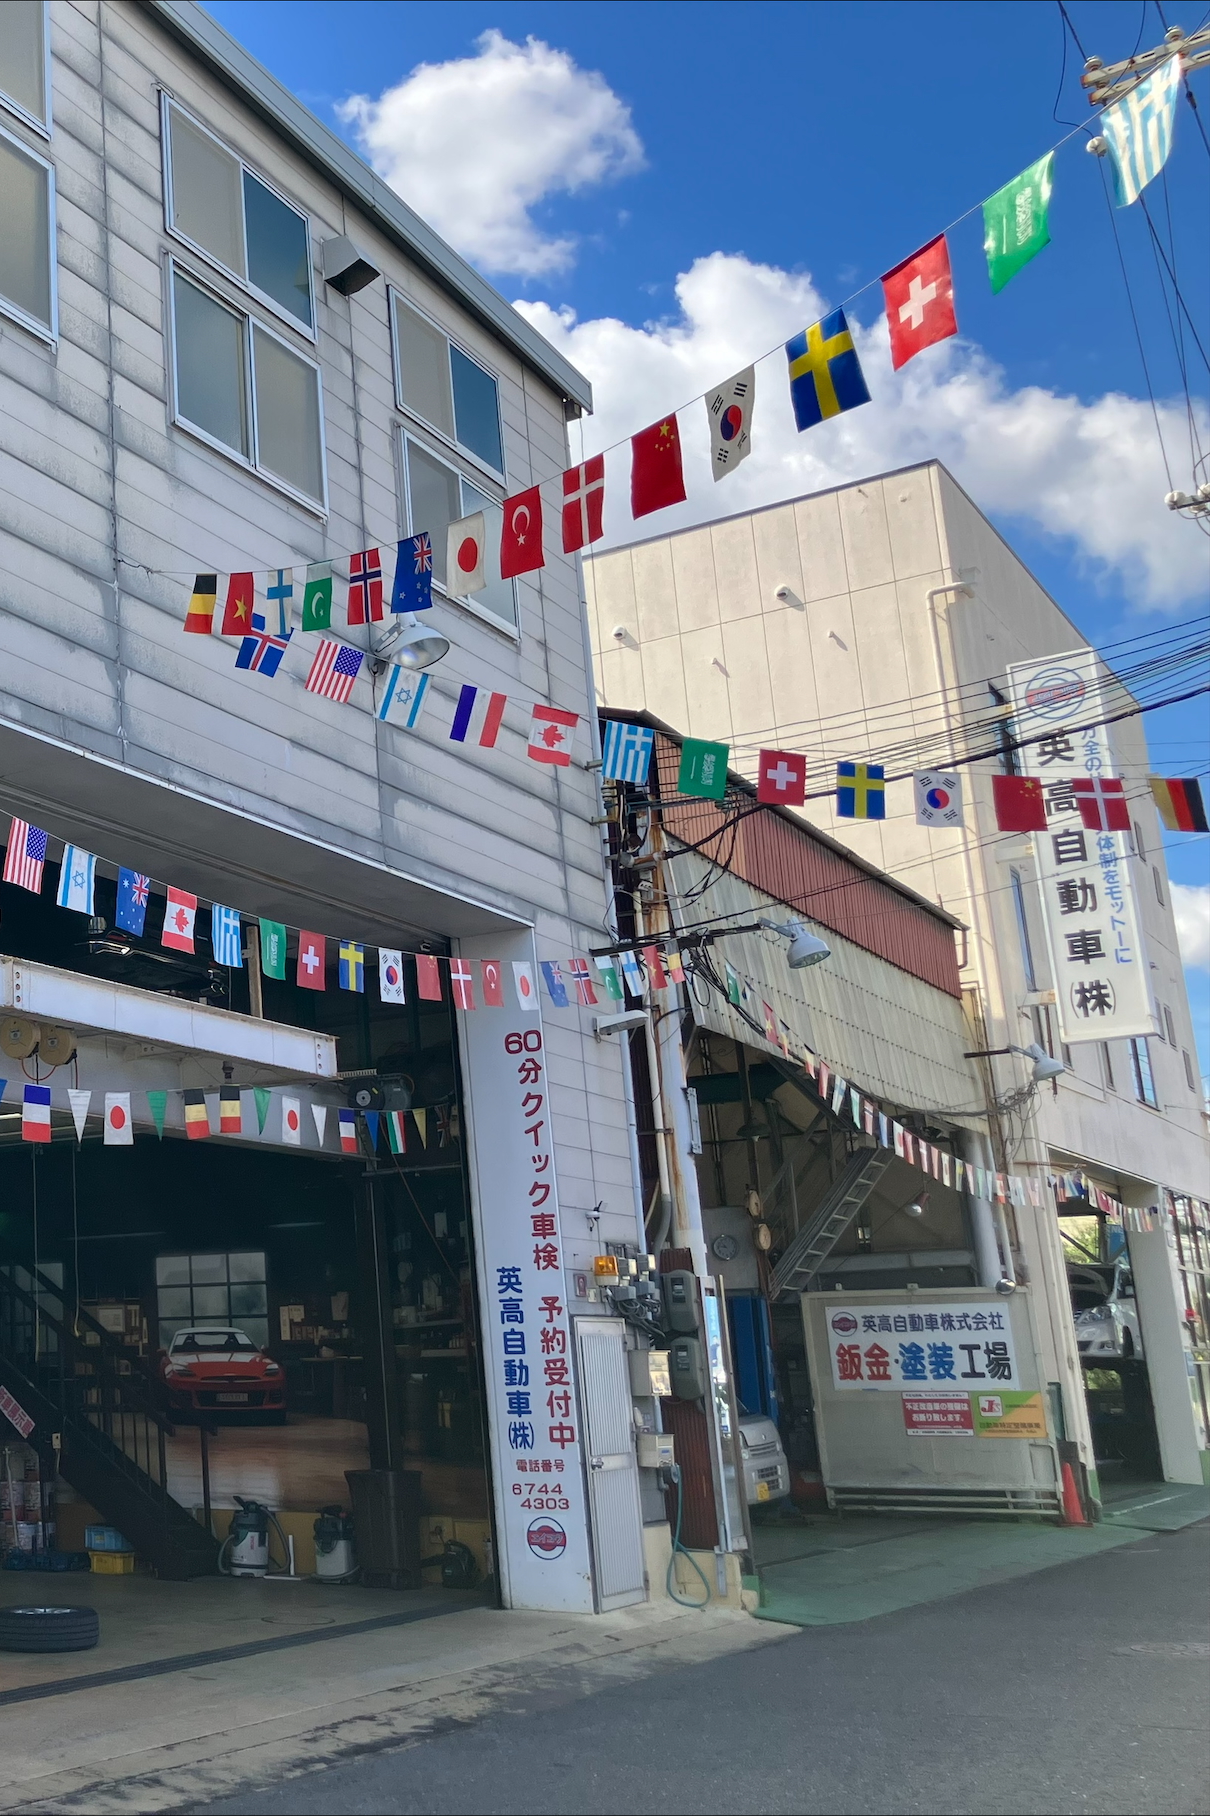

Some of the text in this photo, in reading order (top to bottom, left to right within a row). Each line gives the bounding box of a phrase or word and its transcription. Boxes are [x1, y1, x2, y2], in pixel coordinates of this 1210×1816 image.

[860, 1311, 1005, 1333] 英高自動車株式会社
[537, 1295, 575, 1450] 予約受付中
[515, 1458, 565, 1474] 電話番号
[511, 1482, 563, 1496] 6744
[520, 1497, 570, 1510] 4303
